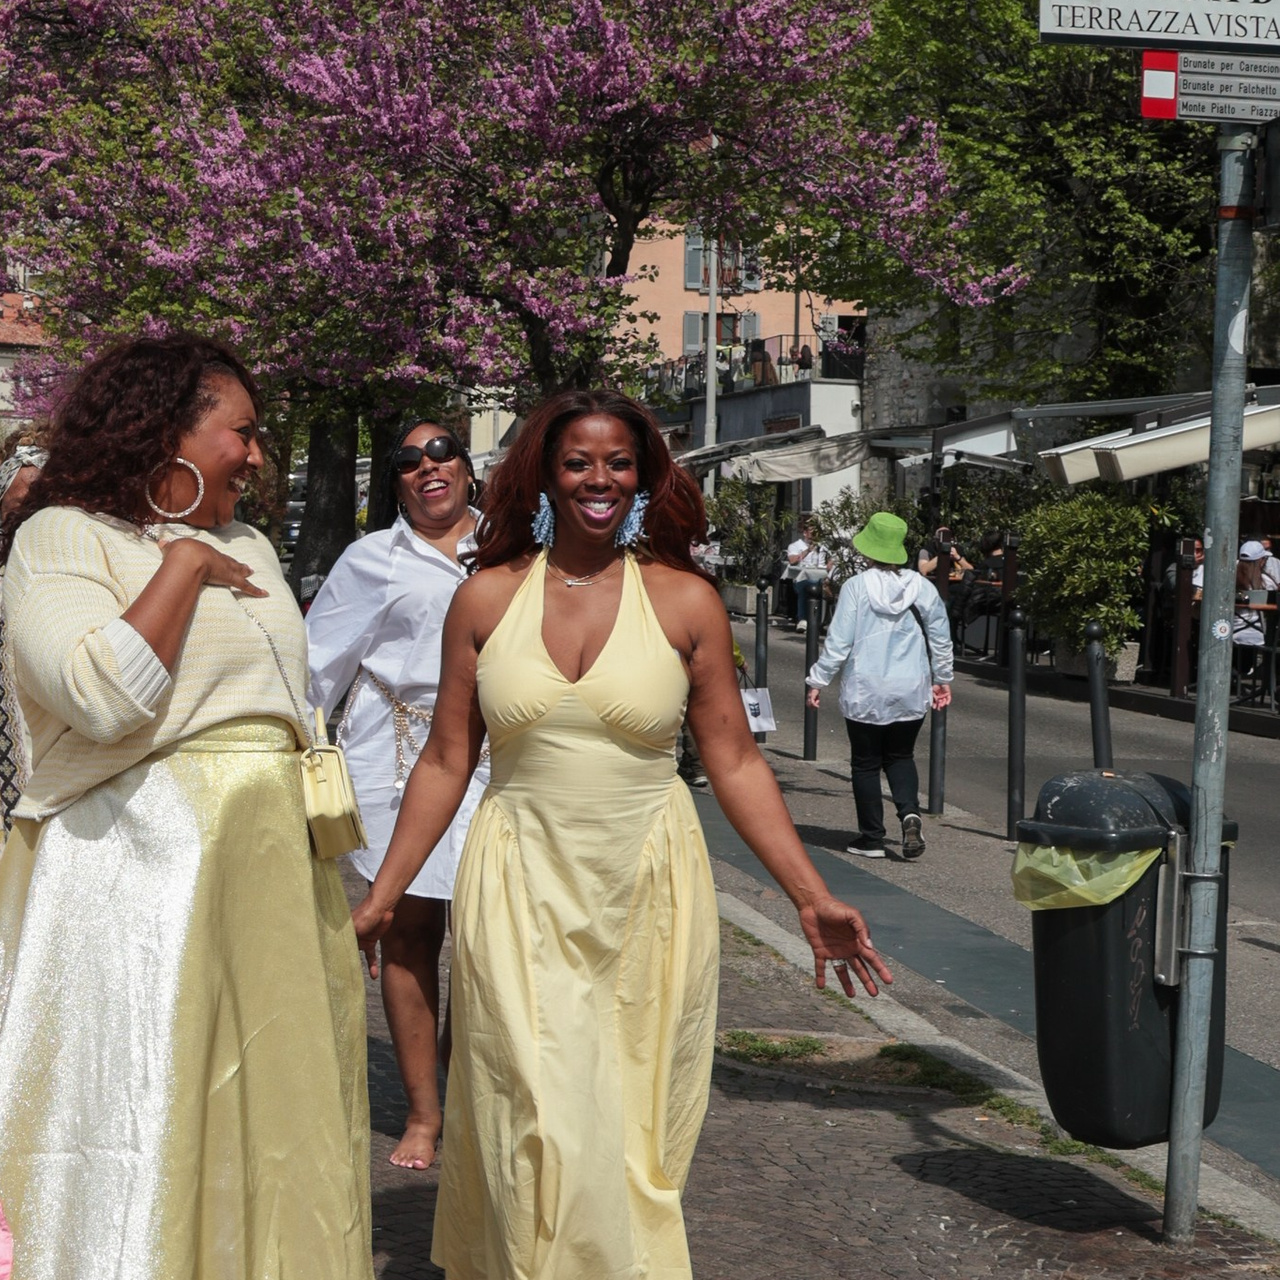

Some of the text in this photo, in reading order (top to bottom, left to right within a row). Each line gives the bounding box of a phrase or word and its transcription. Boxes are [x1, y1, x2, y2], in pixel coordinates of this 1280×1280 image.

[1052, 4, 1280, 40] TERRAZZA VISTA
[1183, 56, 1215, 70] Brunate
[1221, 62, 1234, 72] per
[1182, 79, 1277, 95] Brunate per Falchetto
[1181, 101, 1206, 112] Monte
[1211, 102, 1236, 114] Piatto
